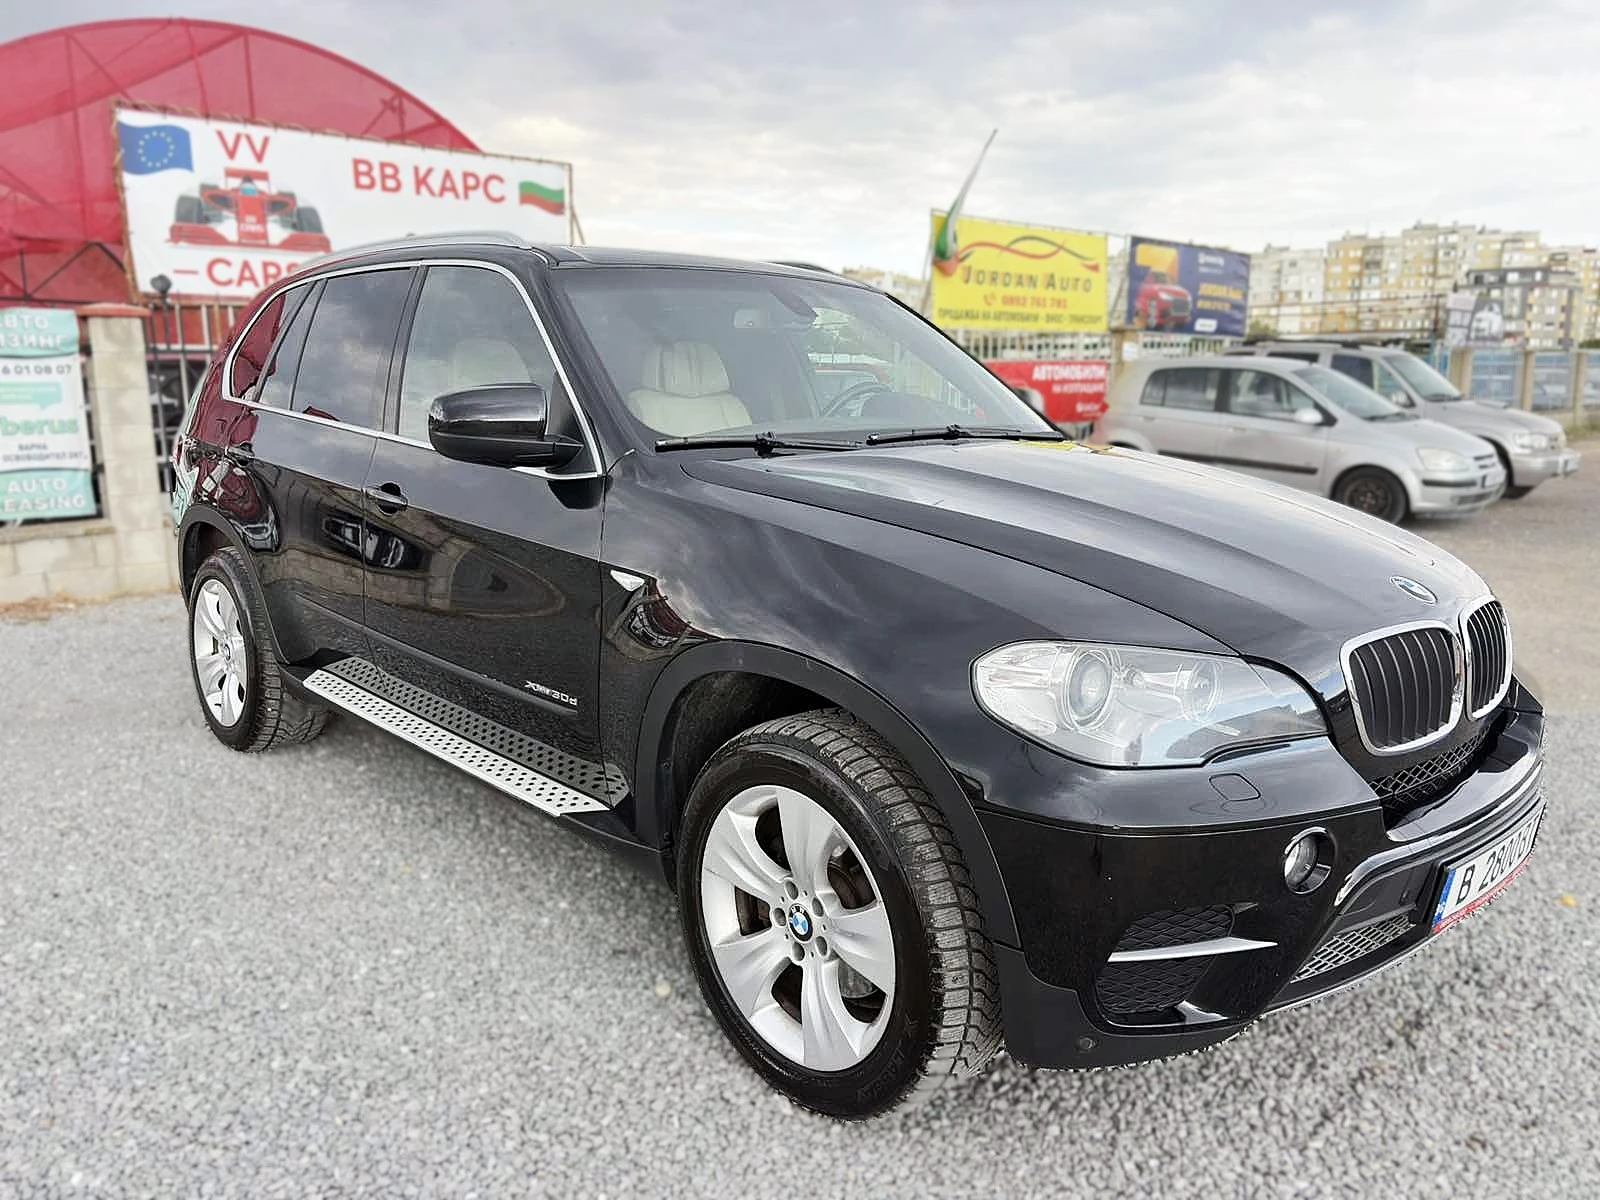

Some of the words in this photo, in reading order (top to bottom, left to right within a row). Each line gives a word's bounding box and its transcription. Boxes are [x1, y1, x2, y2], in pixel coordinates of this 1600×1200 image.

[215, 130, 270, 163] VV
[413, 166, 507, 203] КАРС
[0, 314, 49, 330] ВТО
[7, 477, 68, 494] AUTO
[1456, 864, 1476, 906] B
